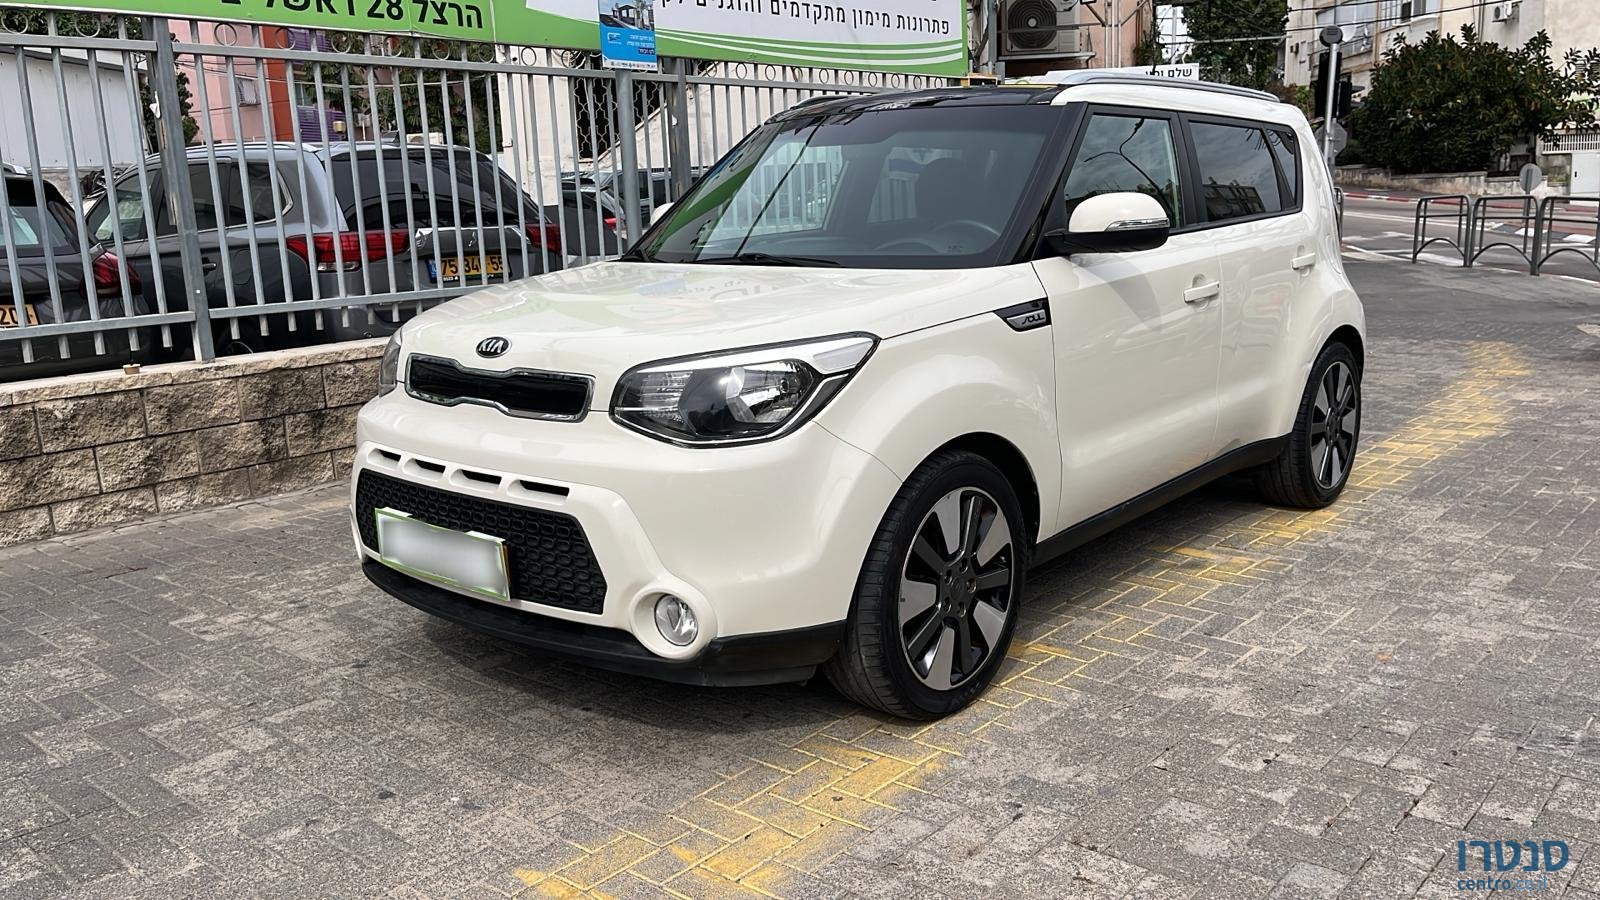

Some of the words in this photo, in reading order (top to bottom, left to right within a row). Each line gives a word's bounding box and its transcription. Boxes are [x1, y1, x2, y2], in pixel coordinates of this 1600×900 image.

[367, 0, 404, 21] 28
[417, 0, 483, 29] הרצל
[770, 0, 846, 24] מתקדמים
[852, 9, 891, 29] מימון
[896, 14, 949, 35] פתרונות
[1167, 67, 1192, 78] שלם
[1021, 312, 1046, 325] SOUL
[478, 338, 505, 354] KIA
